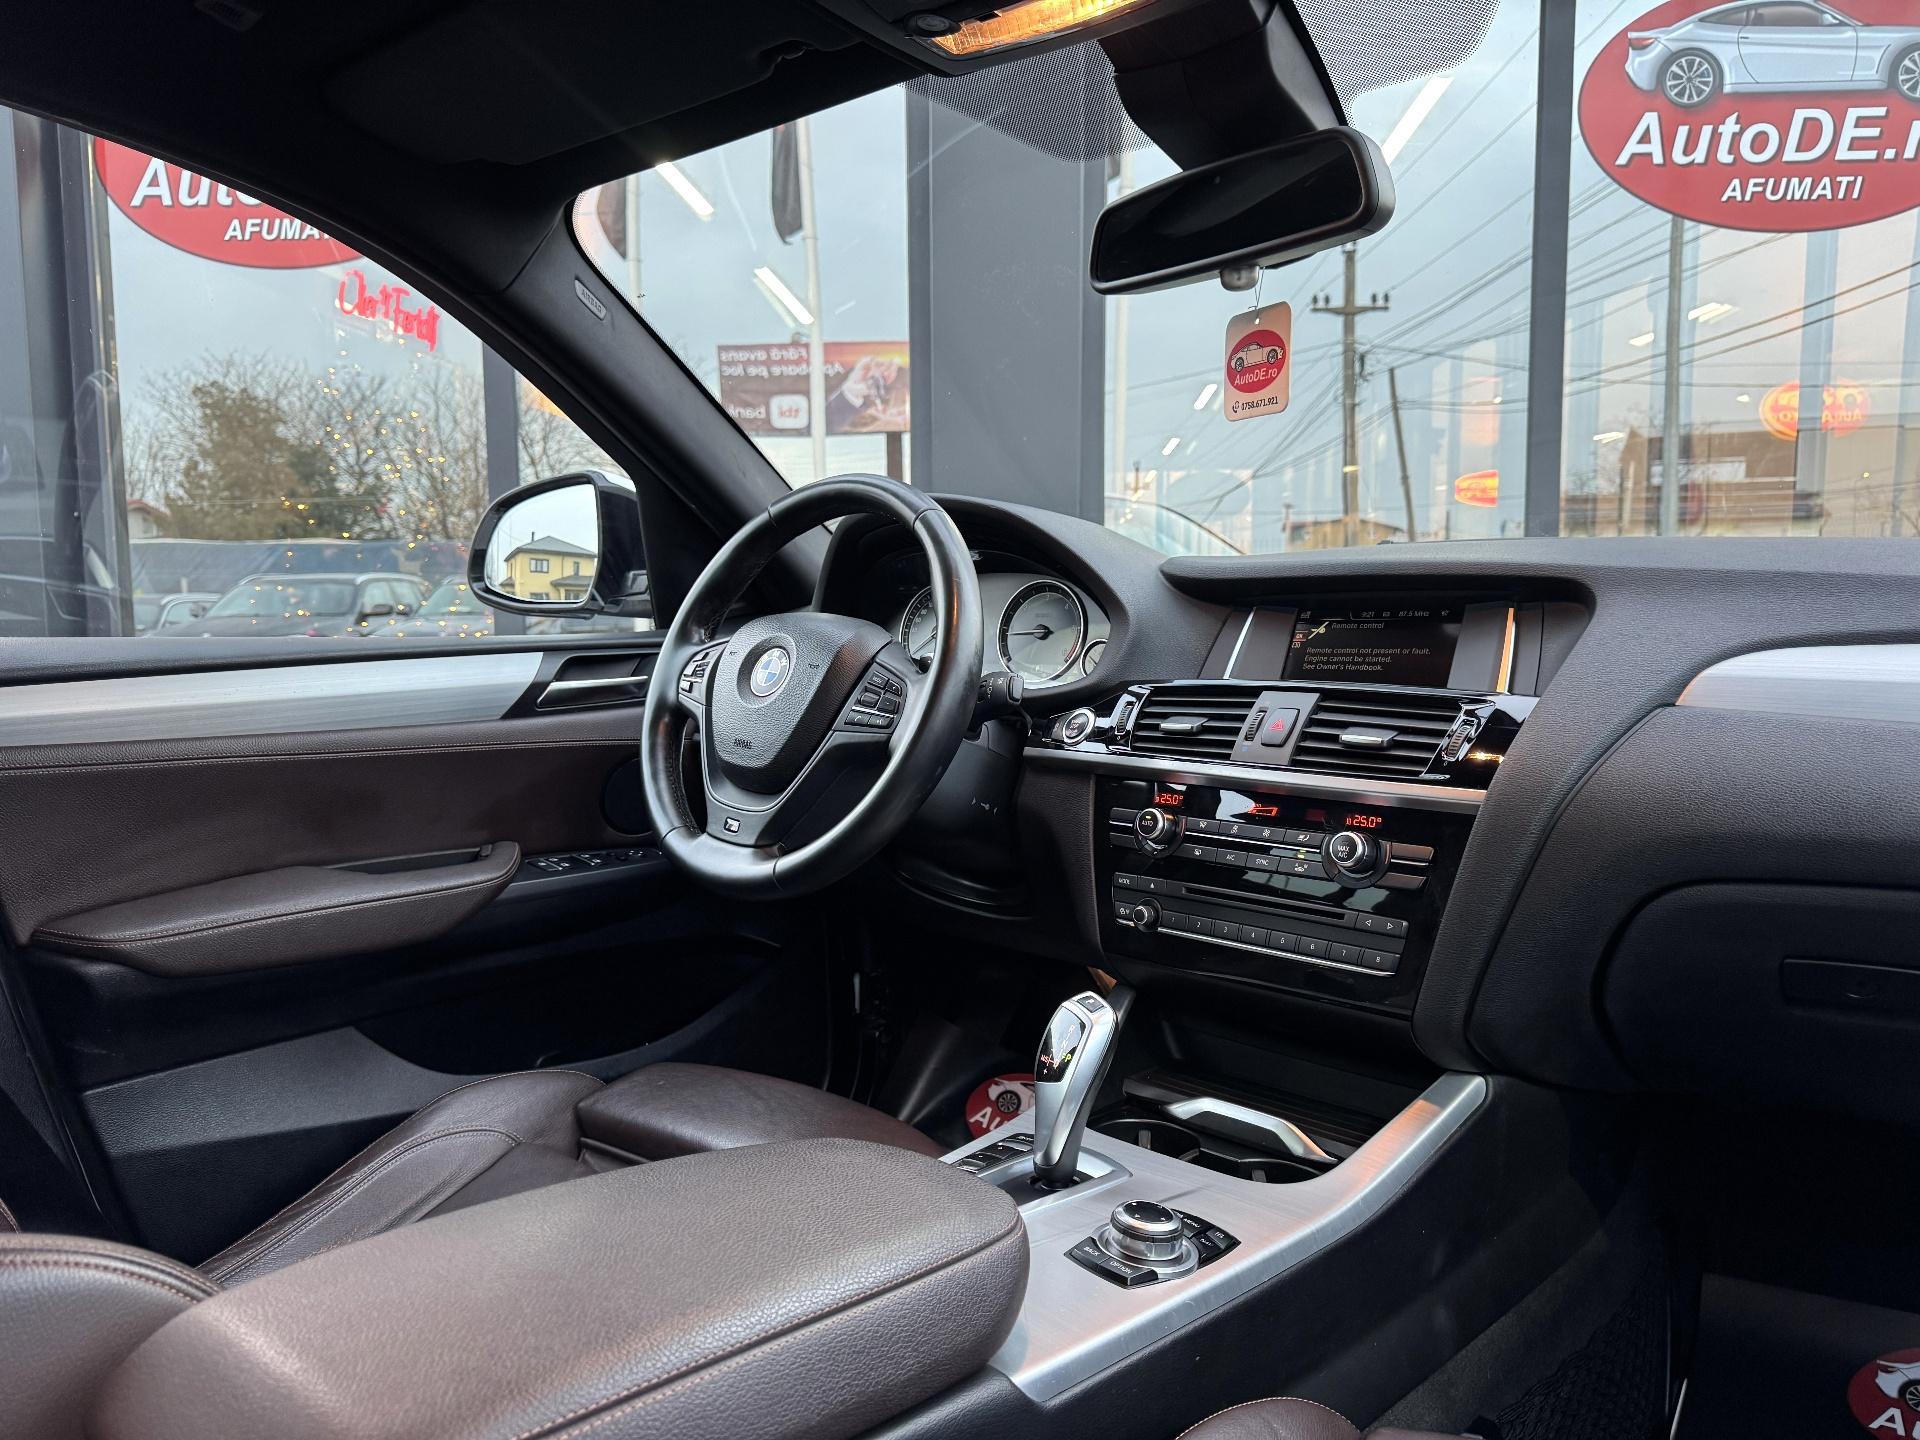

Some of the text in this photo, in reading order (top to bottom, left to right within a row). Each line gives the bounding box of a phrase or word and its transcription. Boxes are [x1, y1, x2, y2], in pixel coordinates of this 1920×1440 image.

[1721, 176, 1864, 203] AFUMATI
[1233, 367, 1279, 387] AutoDE.ro
[1306, 647, 1333, 655] Remote
[1333, 647, 1358, 655] control
[1373, 647, 1401, 656] present
[1411, 647, 1431, 656] fault.
[1304, 655, 1328, 663] Engine
[1141, 818, 1155, 828] AUTO
[1337, 844, 1350, 853] MAX
[1226, 853, 1236, 862] A/C
[1337, 851, 1348, 860] A/C
[1109, 1260, 1134, 1275] OPTION
